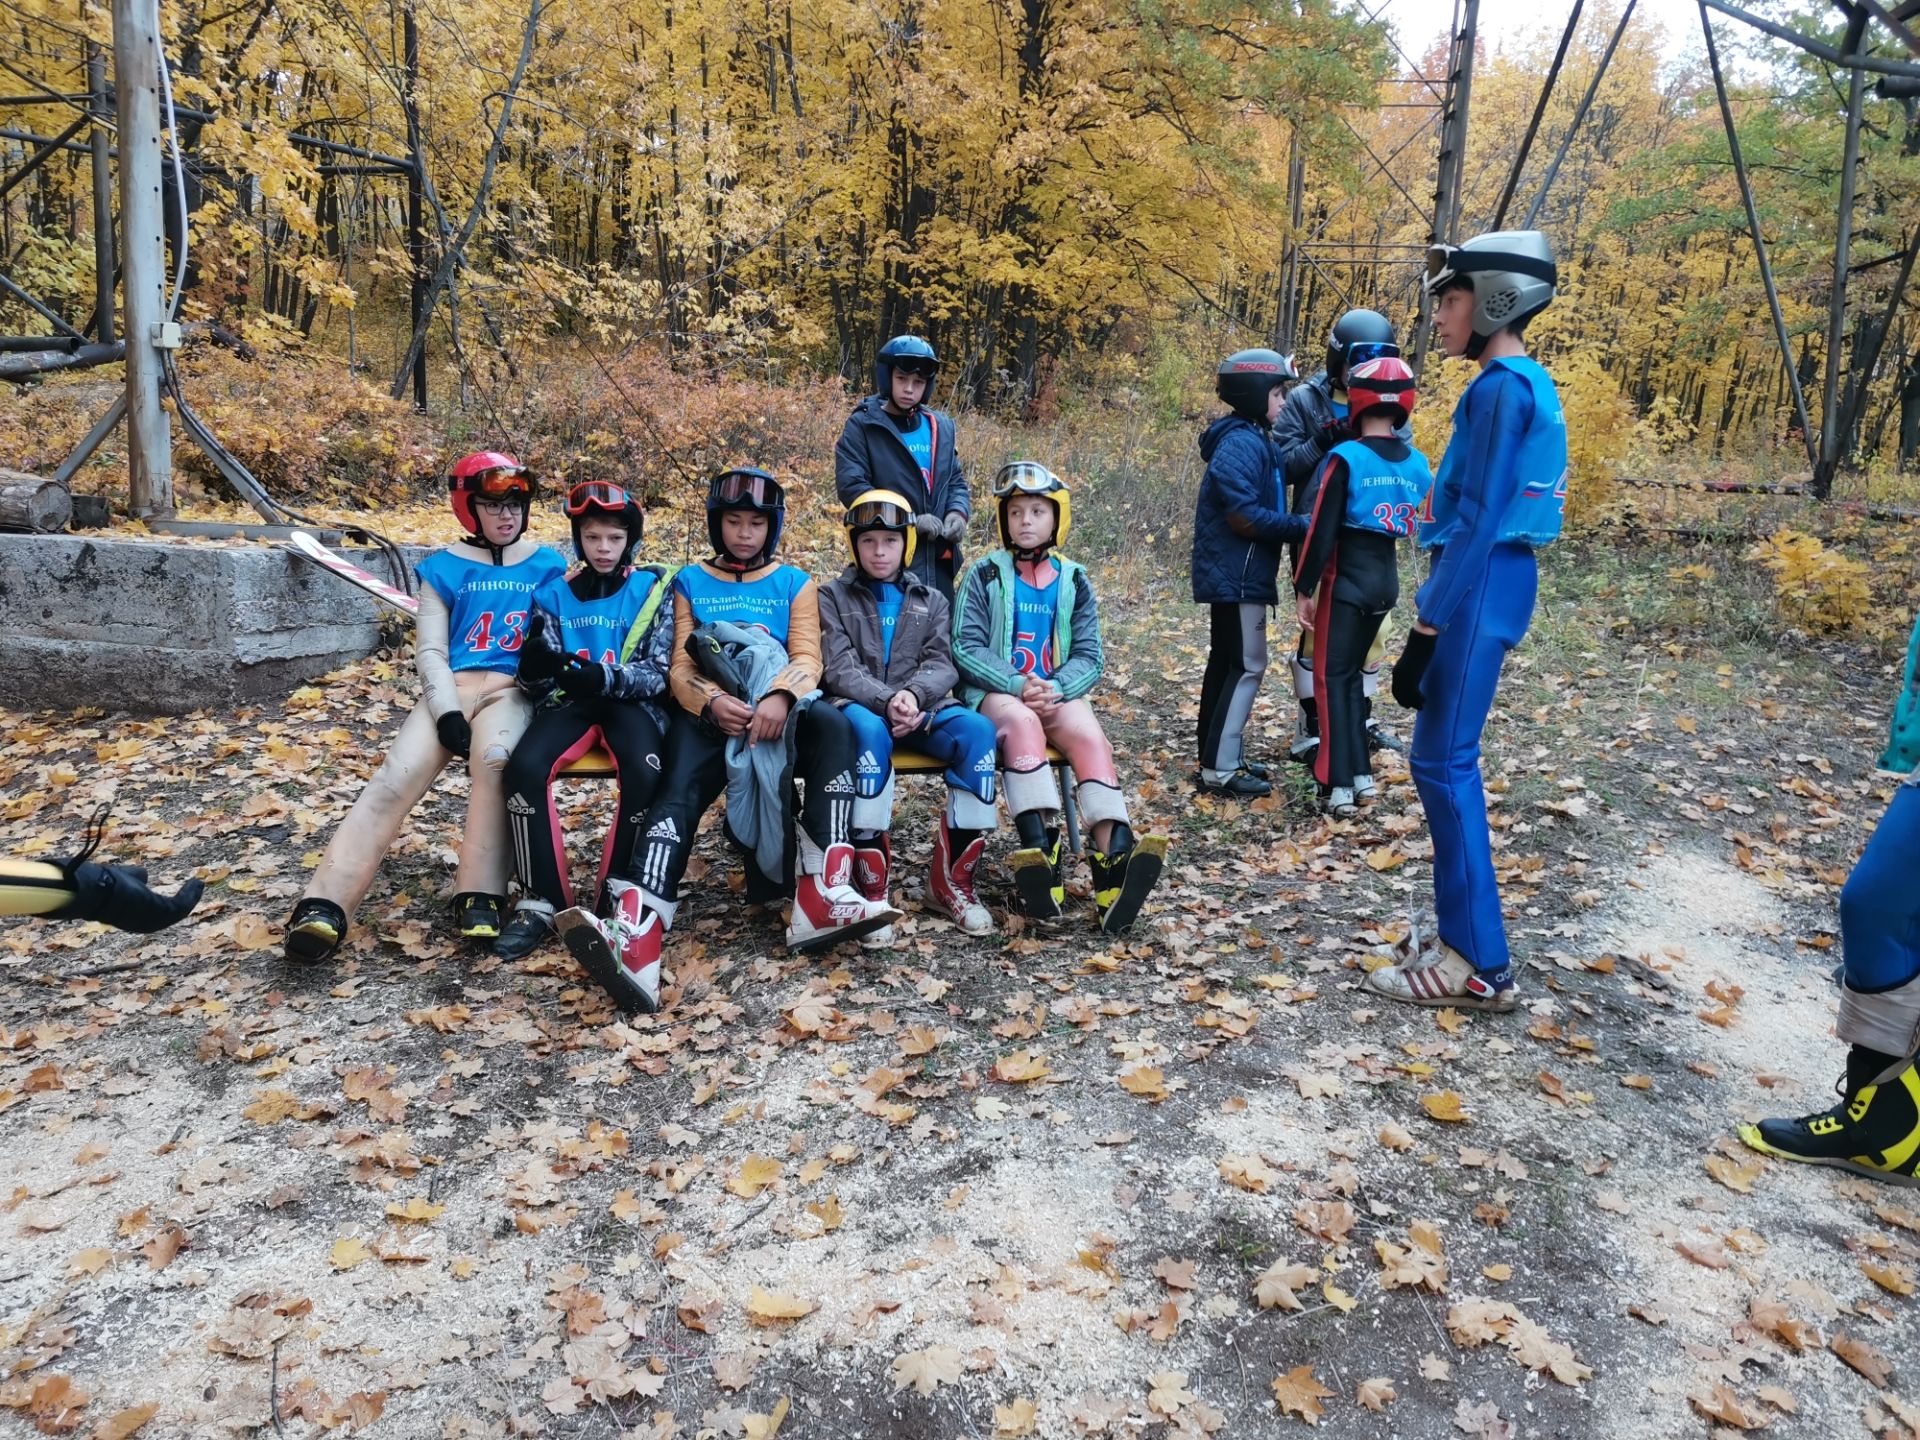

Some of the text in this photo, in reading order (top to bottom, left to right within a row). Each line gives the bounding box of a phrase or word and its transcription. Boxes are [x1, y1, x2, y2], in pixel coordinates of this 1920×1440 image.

[1374, 503, 1416, 535] 33
[465, 611, 528, 652] 43
[647, 829, 681, 843] adidas
